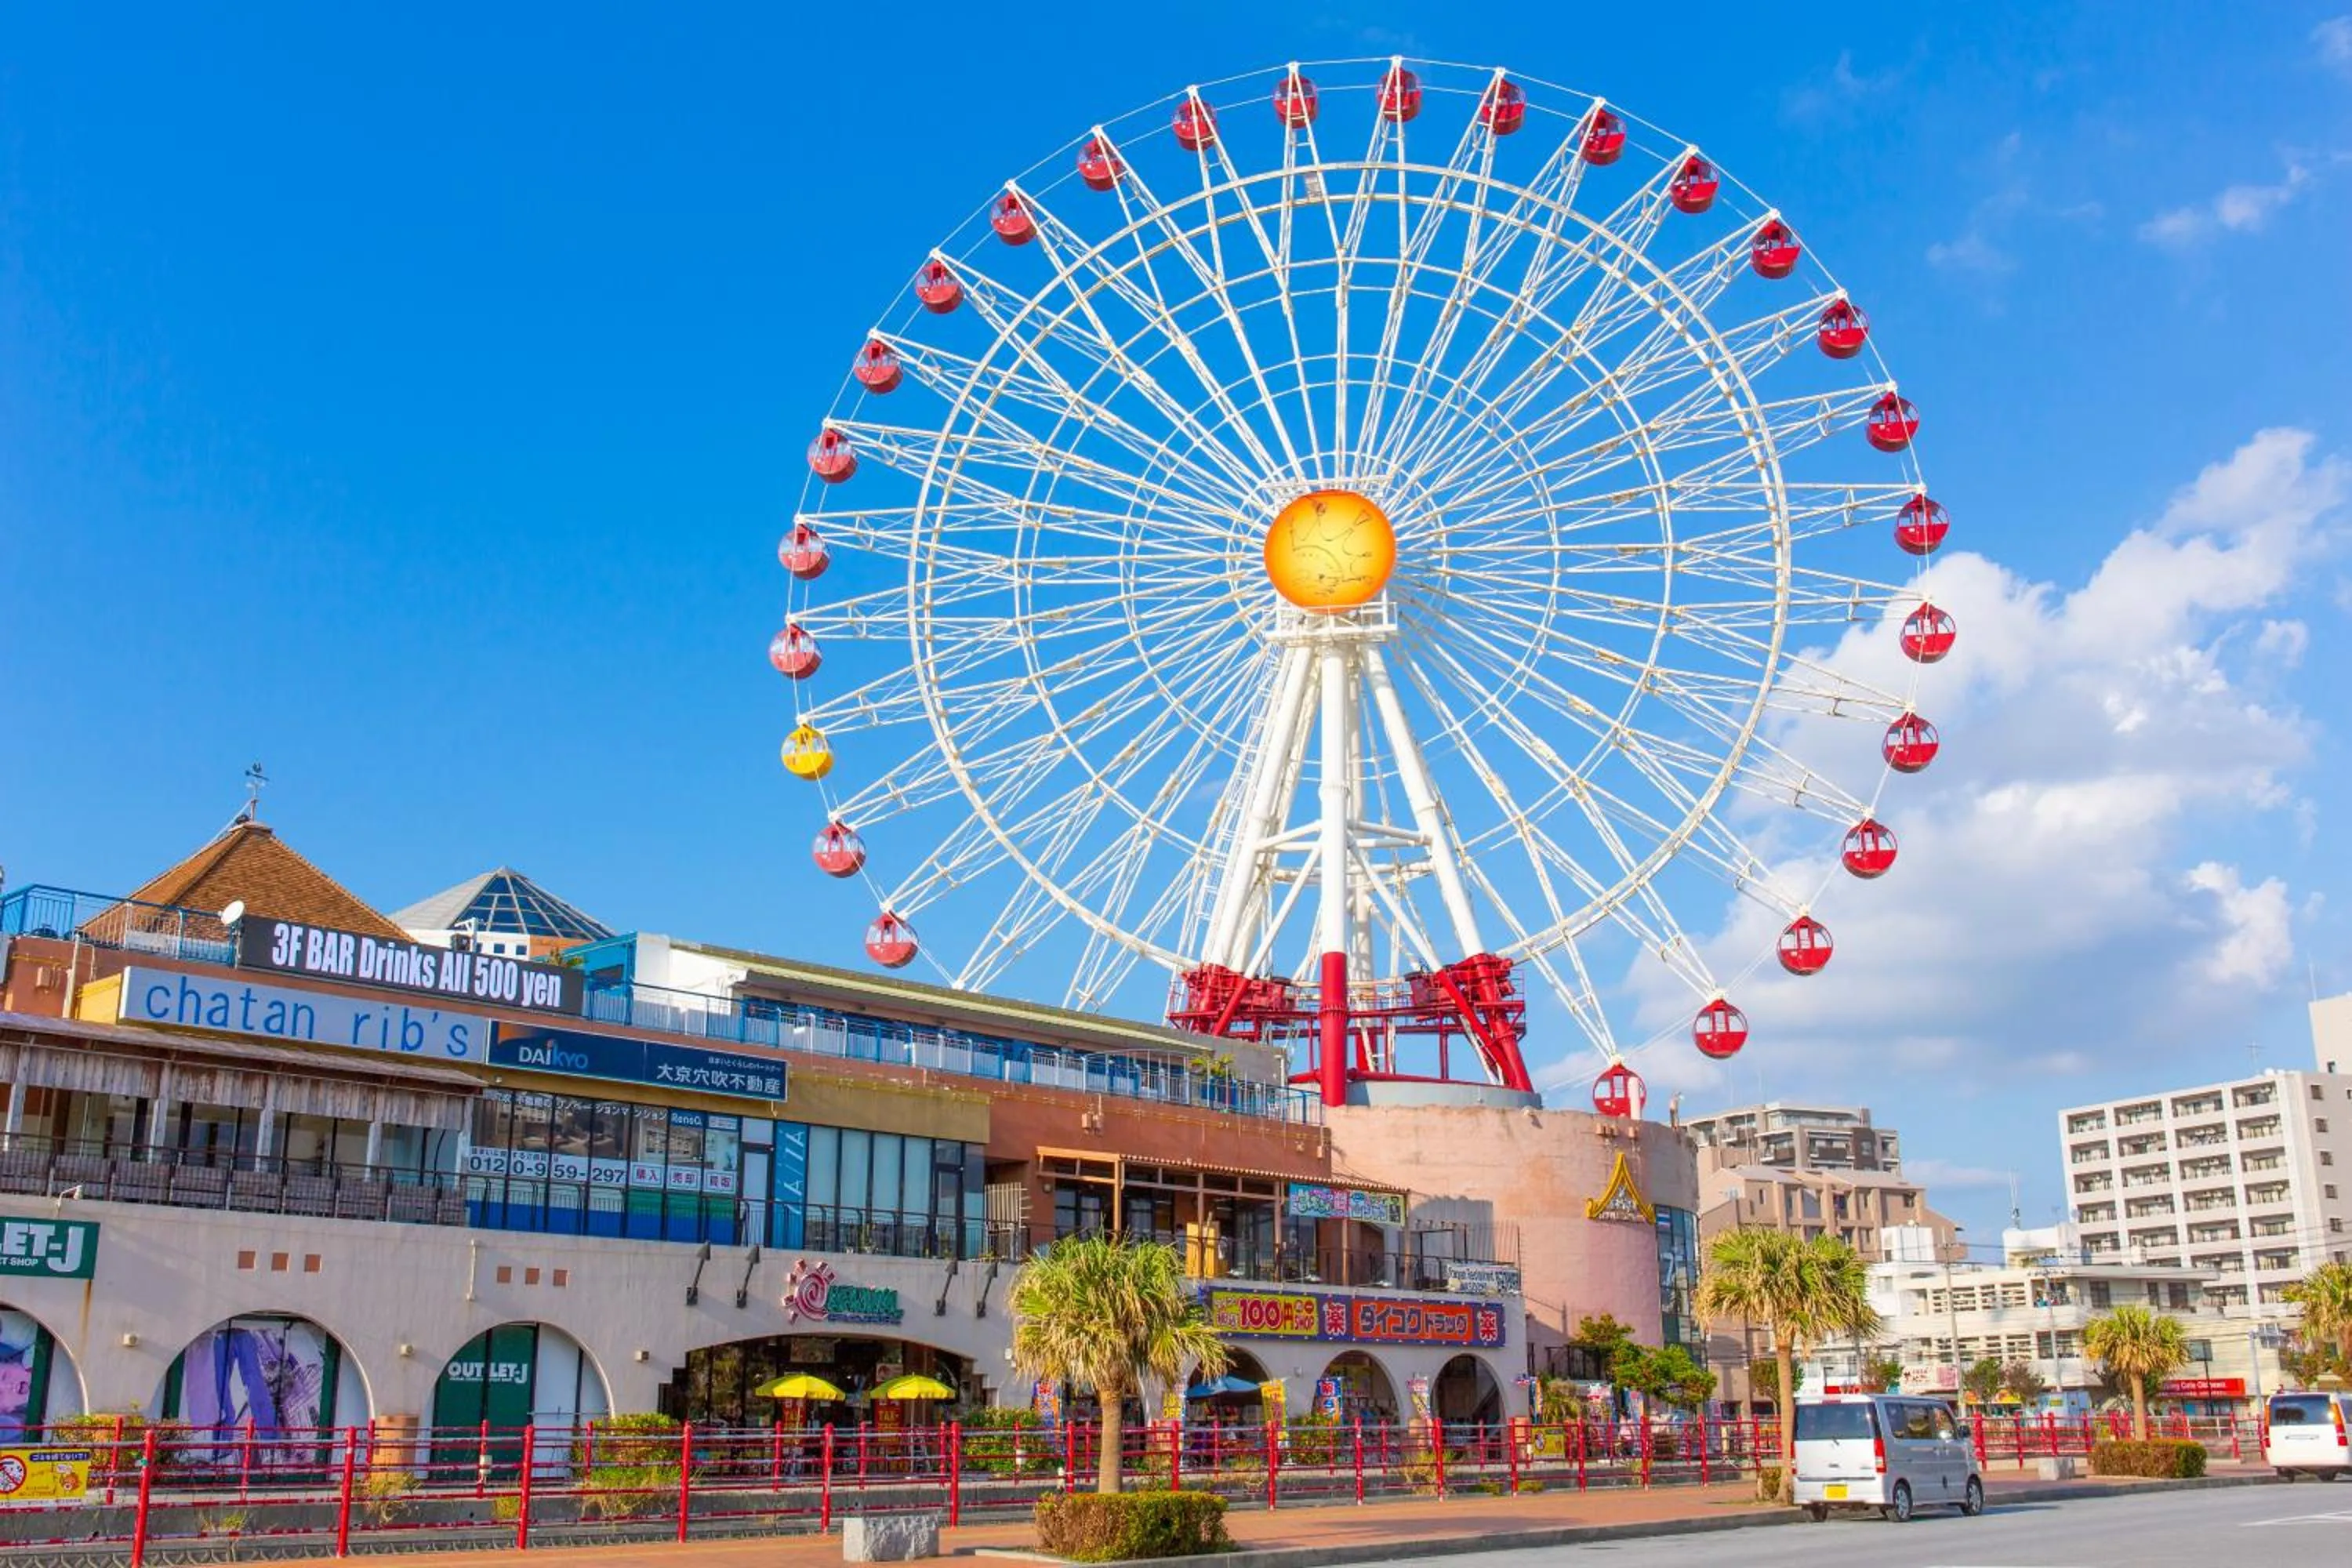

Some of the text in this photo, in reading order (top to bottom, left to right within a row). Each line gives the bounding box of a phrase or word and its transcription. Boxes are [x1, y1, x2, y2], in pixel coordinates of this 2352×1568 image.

[272, 923, 561, 1008] 3F BAR Drinks All 500 yen
[146, 976, 469, 1057] chatan rib's
[656, 1063, 780, 1095] 大京穴吹不動産
[0, 1222, 85, 1272] ET-J
[1294, 1315, 1315, 1330] SHOP
